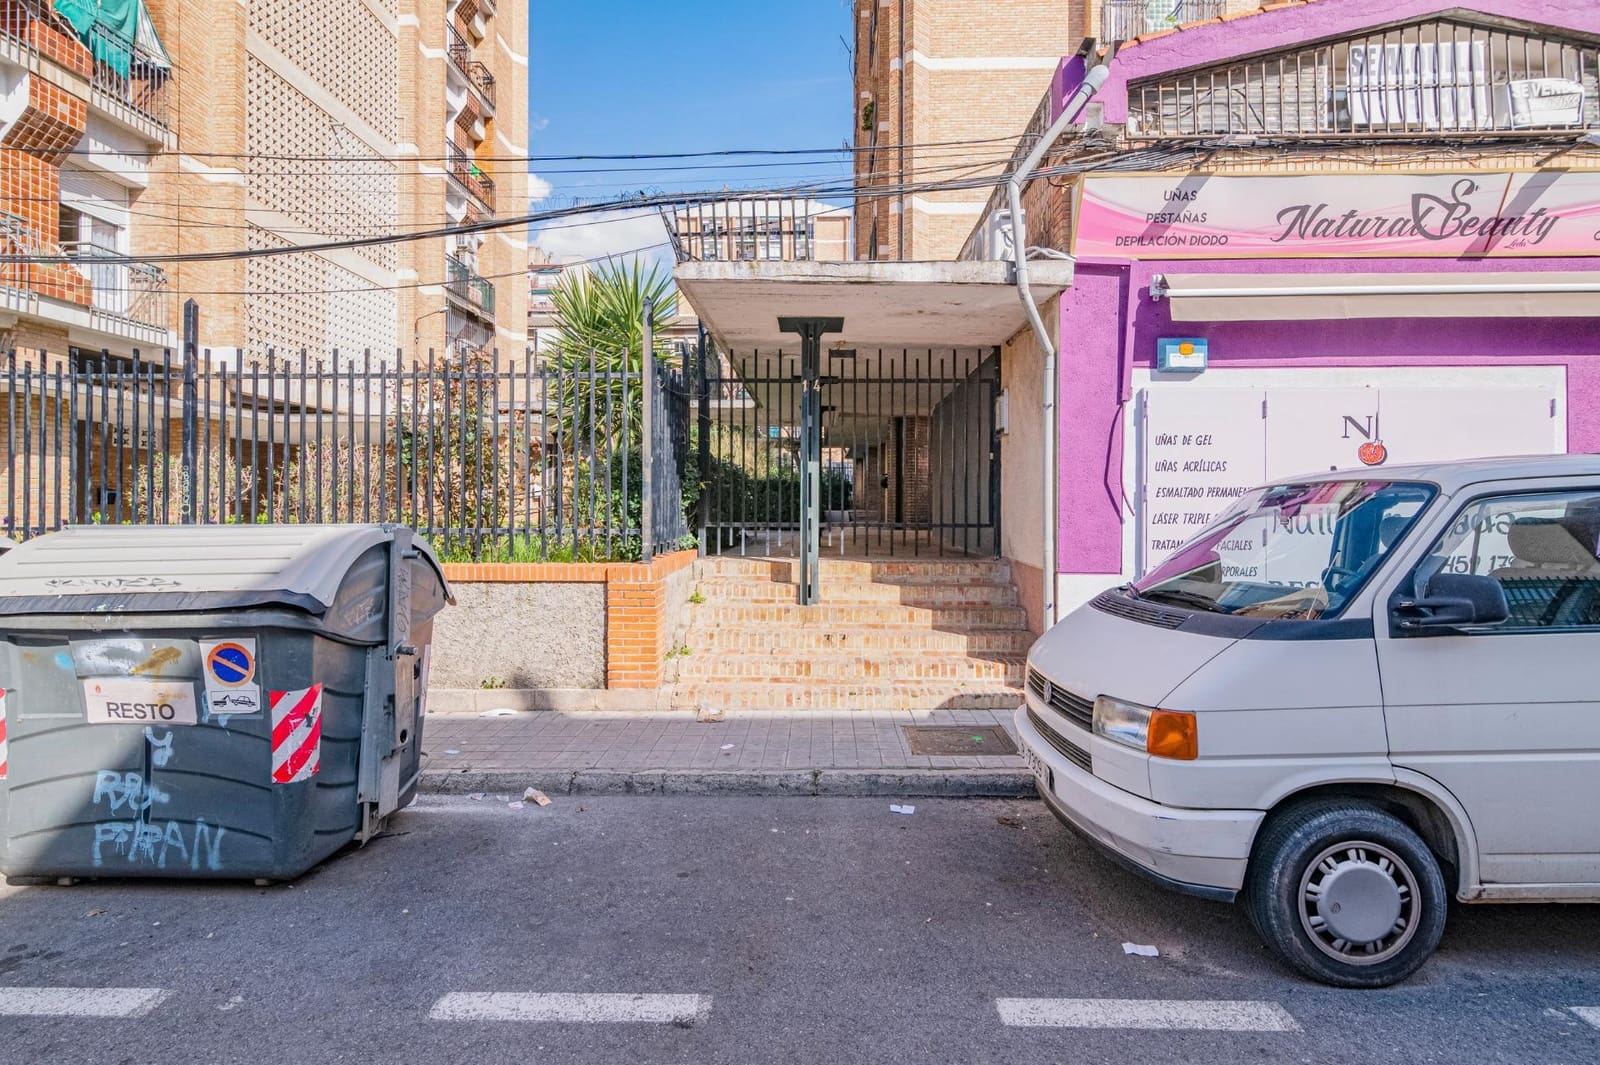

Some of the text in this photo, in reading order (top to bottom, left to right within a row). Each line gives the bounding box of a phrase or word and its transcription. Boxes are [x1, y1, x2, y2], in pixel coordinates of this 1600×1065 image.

[1163, 188, 1198, 201] UÑAS
[1145, 210, 1207, 223] PESTAÑAS
[1270, 202, 1560, 244] Natural Beauty
[1115, 233, 1229, 247] DEPILACIÓN DIODO
[1155, 433, 1213, 446] UÑAS DE GEL
[1155, 459, 1228, 473] UÑAS ACRÍLICAS
[1156, 486, 1205, 498] ESMALTADO
[1152, 511, 1180, 525] LÁSER
[1221, 566, 1259, 578] RPORALES
[107, 701, 176, 721] RESTO
